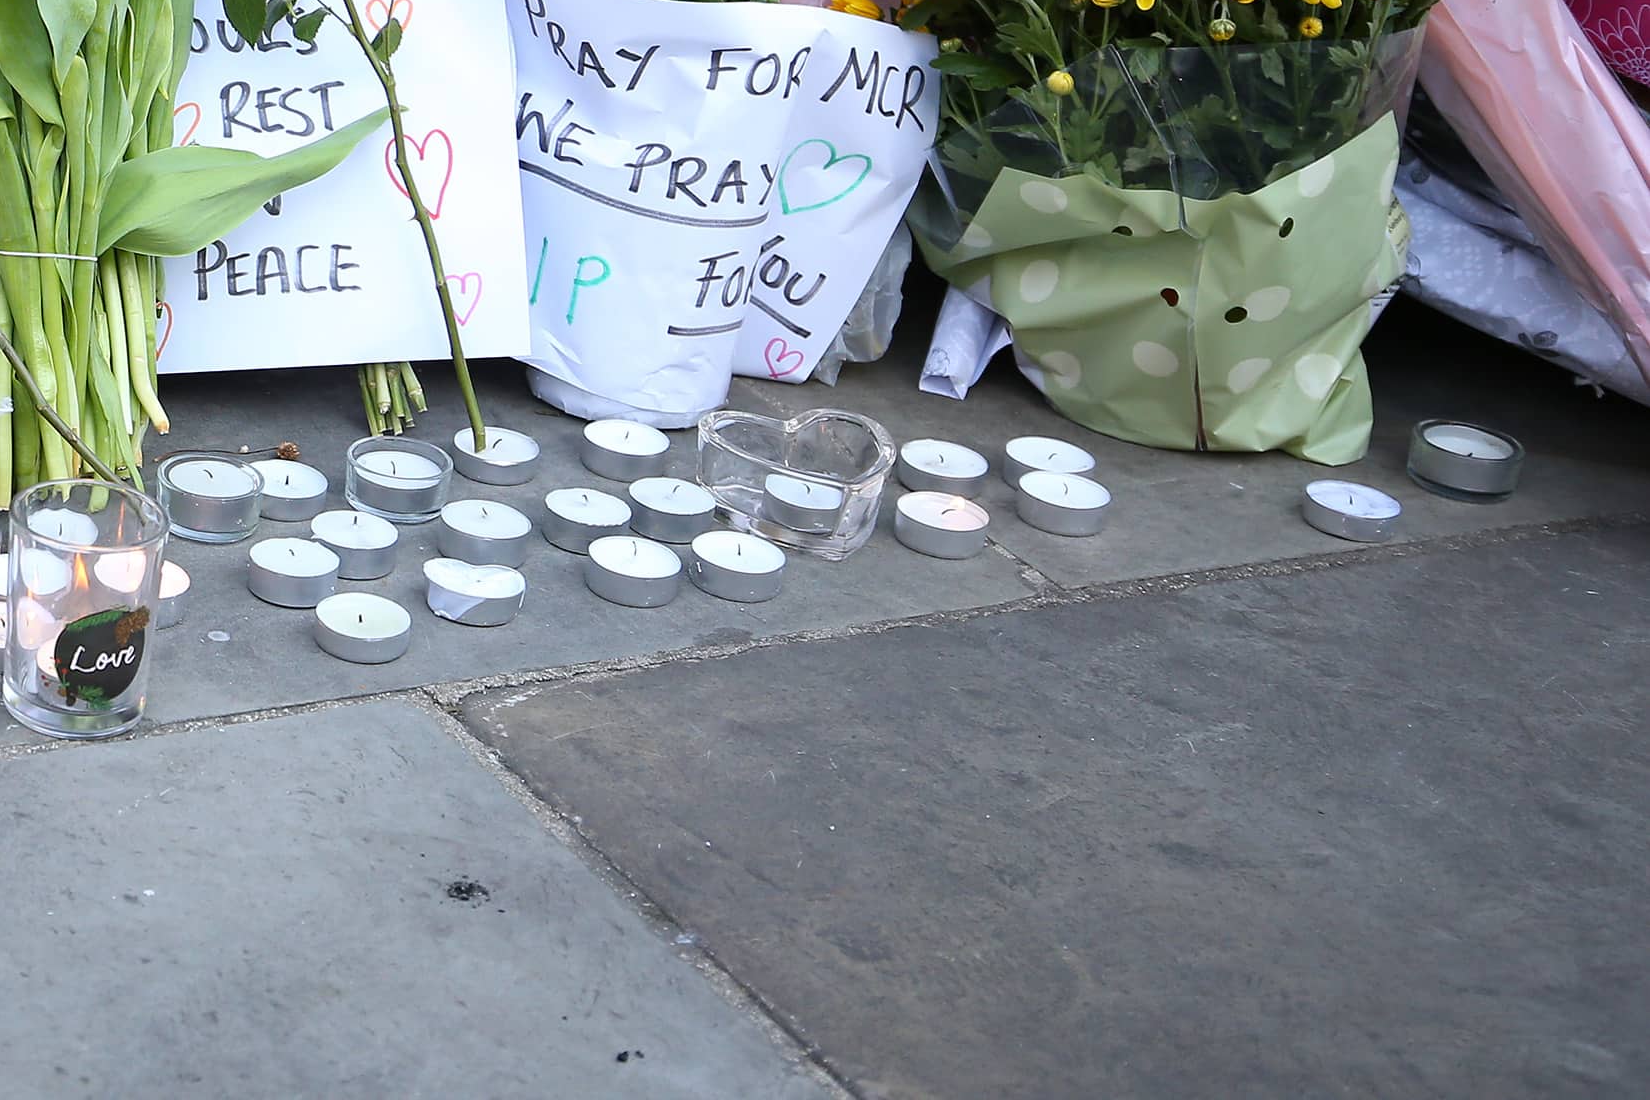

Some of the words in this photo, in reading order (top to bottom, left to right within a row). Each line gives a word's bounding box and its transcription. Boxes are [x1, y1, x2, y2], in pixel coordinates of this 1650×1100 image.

[219, 80, 345, 139] REST
[705, 46, 812, 100] FOR
[819, 46, 927, 133] MCR
[516, 92, 596, 167] WE
[624, 142, 778, 208] PRAY
[194, 240, 362, 301] PEACE
[70, 645, 136, 673] Love
